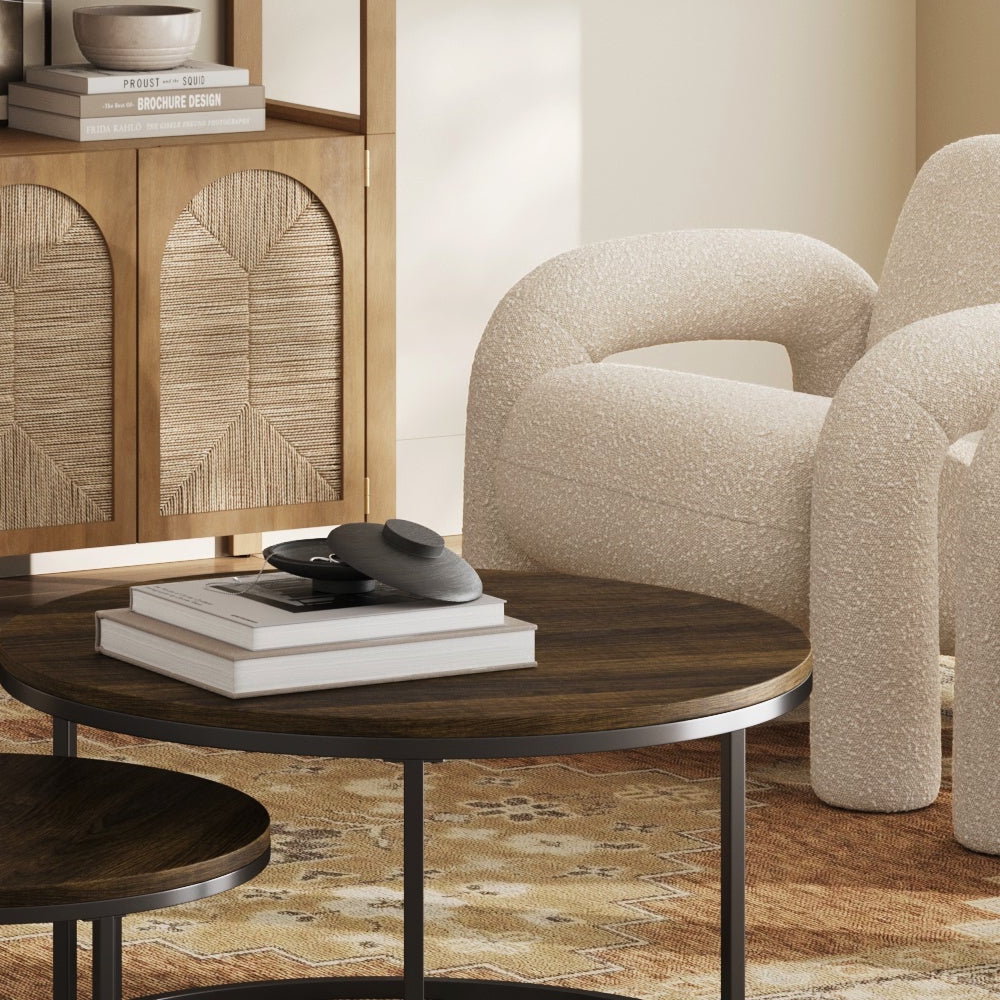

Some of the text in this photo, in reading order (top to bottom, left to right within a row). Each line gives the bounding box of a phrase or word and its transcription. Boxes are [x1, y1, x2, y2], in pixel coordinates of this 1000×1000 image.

[123, 77, 160, 89] PROUST
[182, 75, 206, 86] SQUID
[137, 94, 187, 111] BROCHURE
[188, 92, 222, 108] DESIGN
[86, 124, 111, 135] FRIDA
[113, 122, 142, 133] KAHLO
